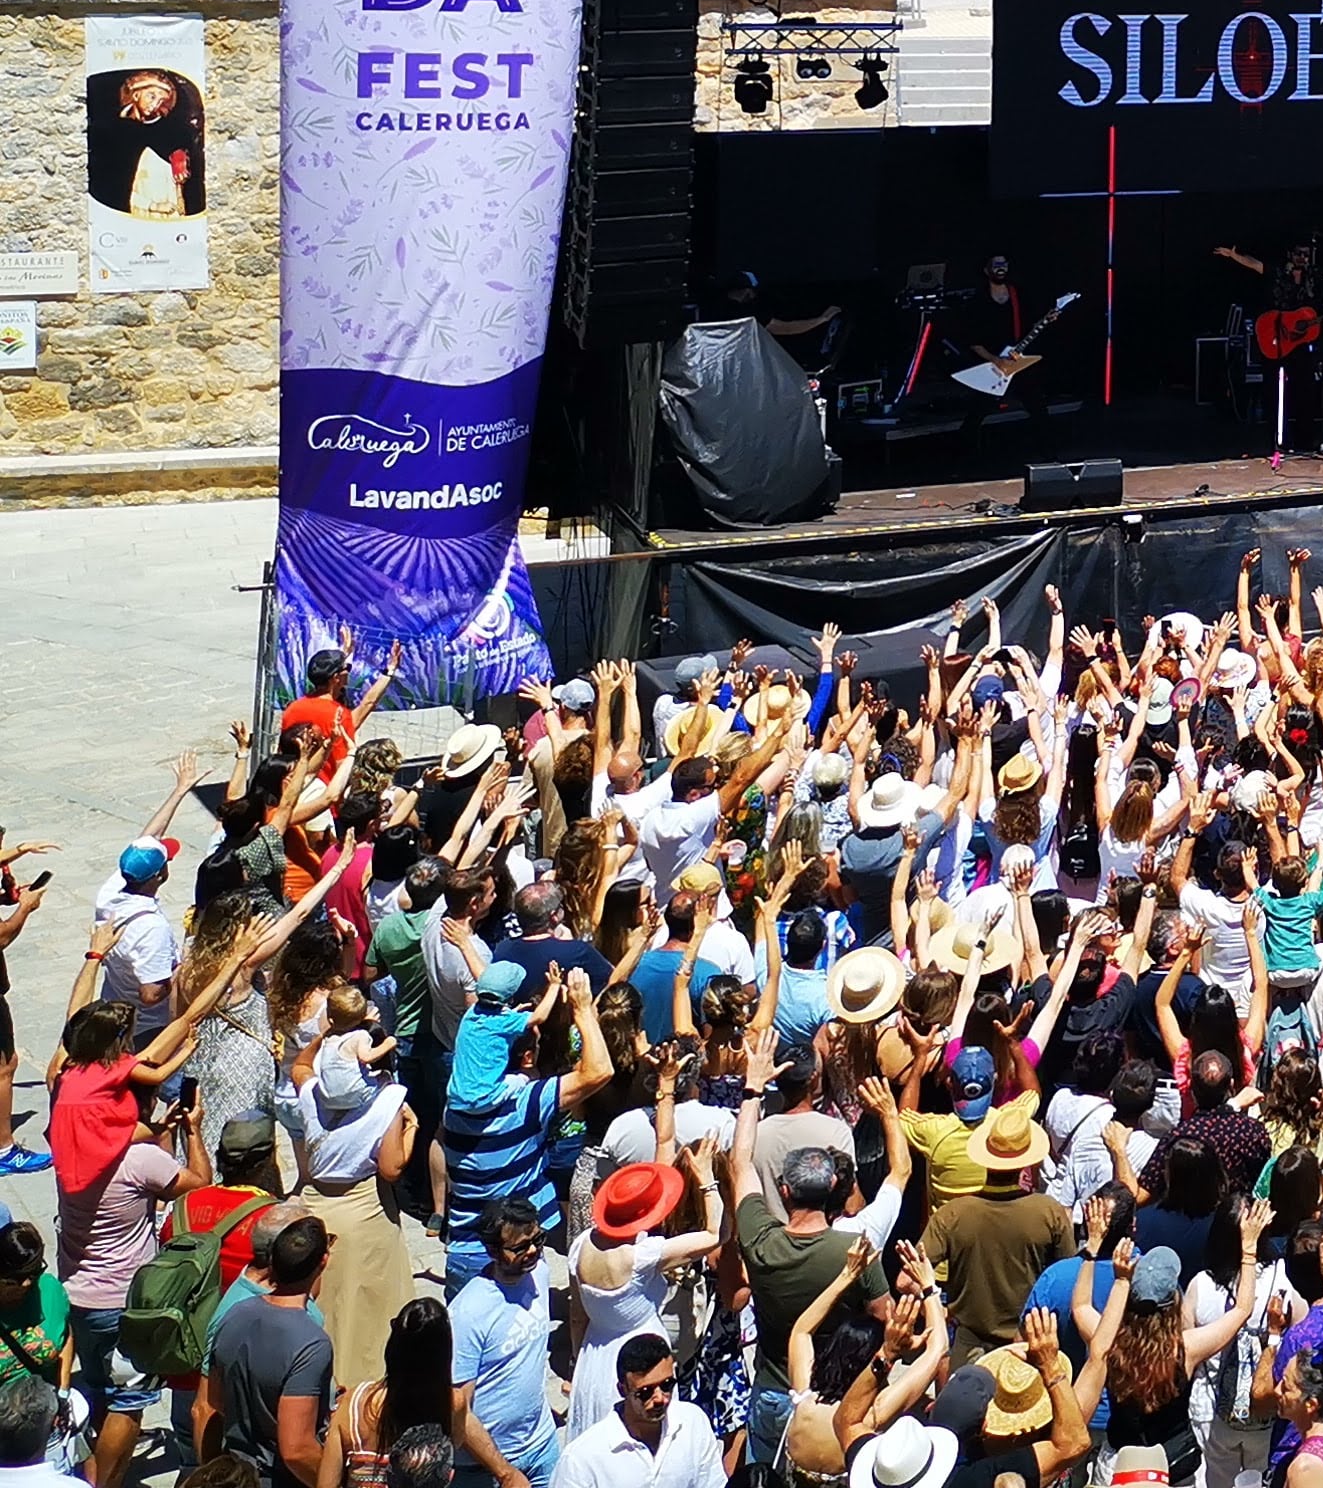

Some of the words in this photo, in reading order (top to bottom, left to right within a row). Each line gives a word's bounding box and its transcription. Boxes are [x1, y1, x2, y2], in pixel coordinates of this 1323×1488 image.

[356, 52, 534, 100] FEST
[355, 112, 530, 132] CALERUEGA
[308, 413, 430, 468] Caleruega
[446, 437, 467, 452] DE
[350, 481, 503, 510] LavandAsoc
